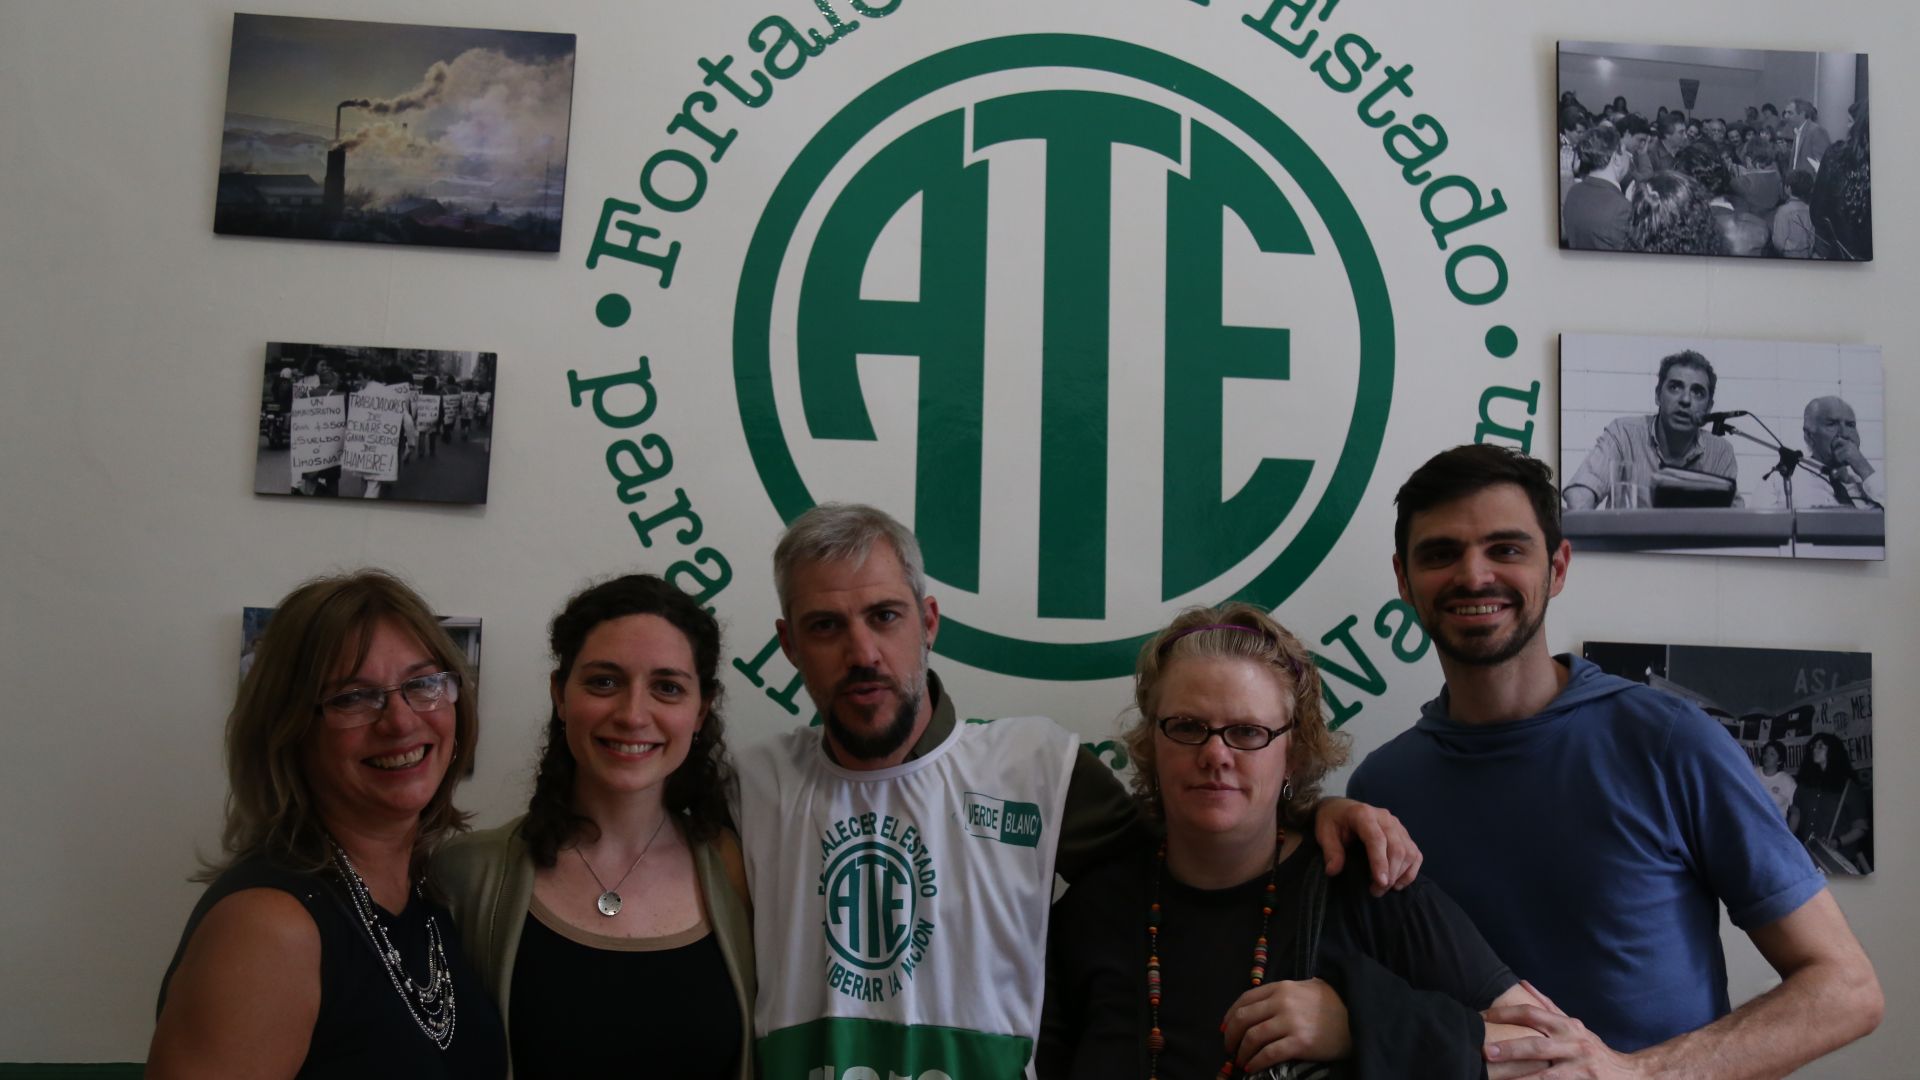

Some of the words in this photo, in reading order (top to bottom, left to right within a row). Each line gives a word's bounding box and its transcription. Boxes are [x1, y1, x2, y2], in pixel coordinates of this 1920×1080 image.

[797, 89, 1315, 619] ATE
[566, 355, 733, 616] para
[898, 825, 938, 898] ESTADO
[968, 803, 998, 831] VERDE
[828, 853, 909, 959] ATE
